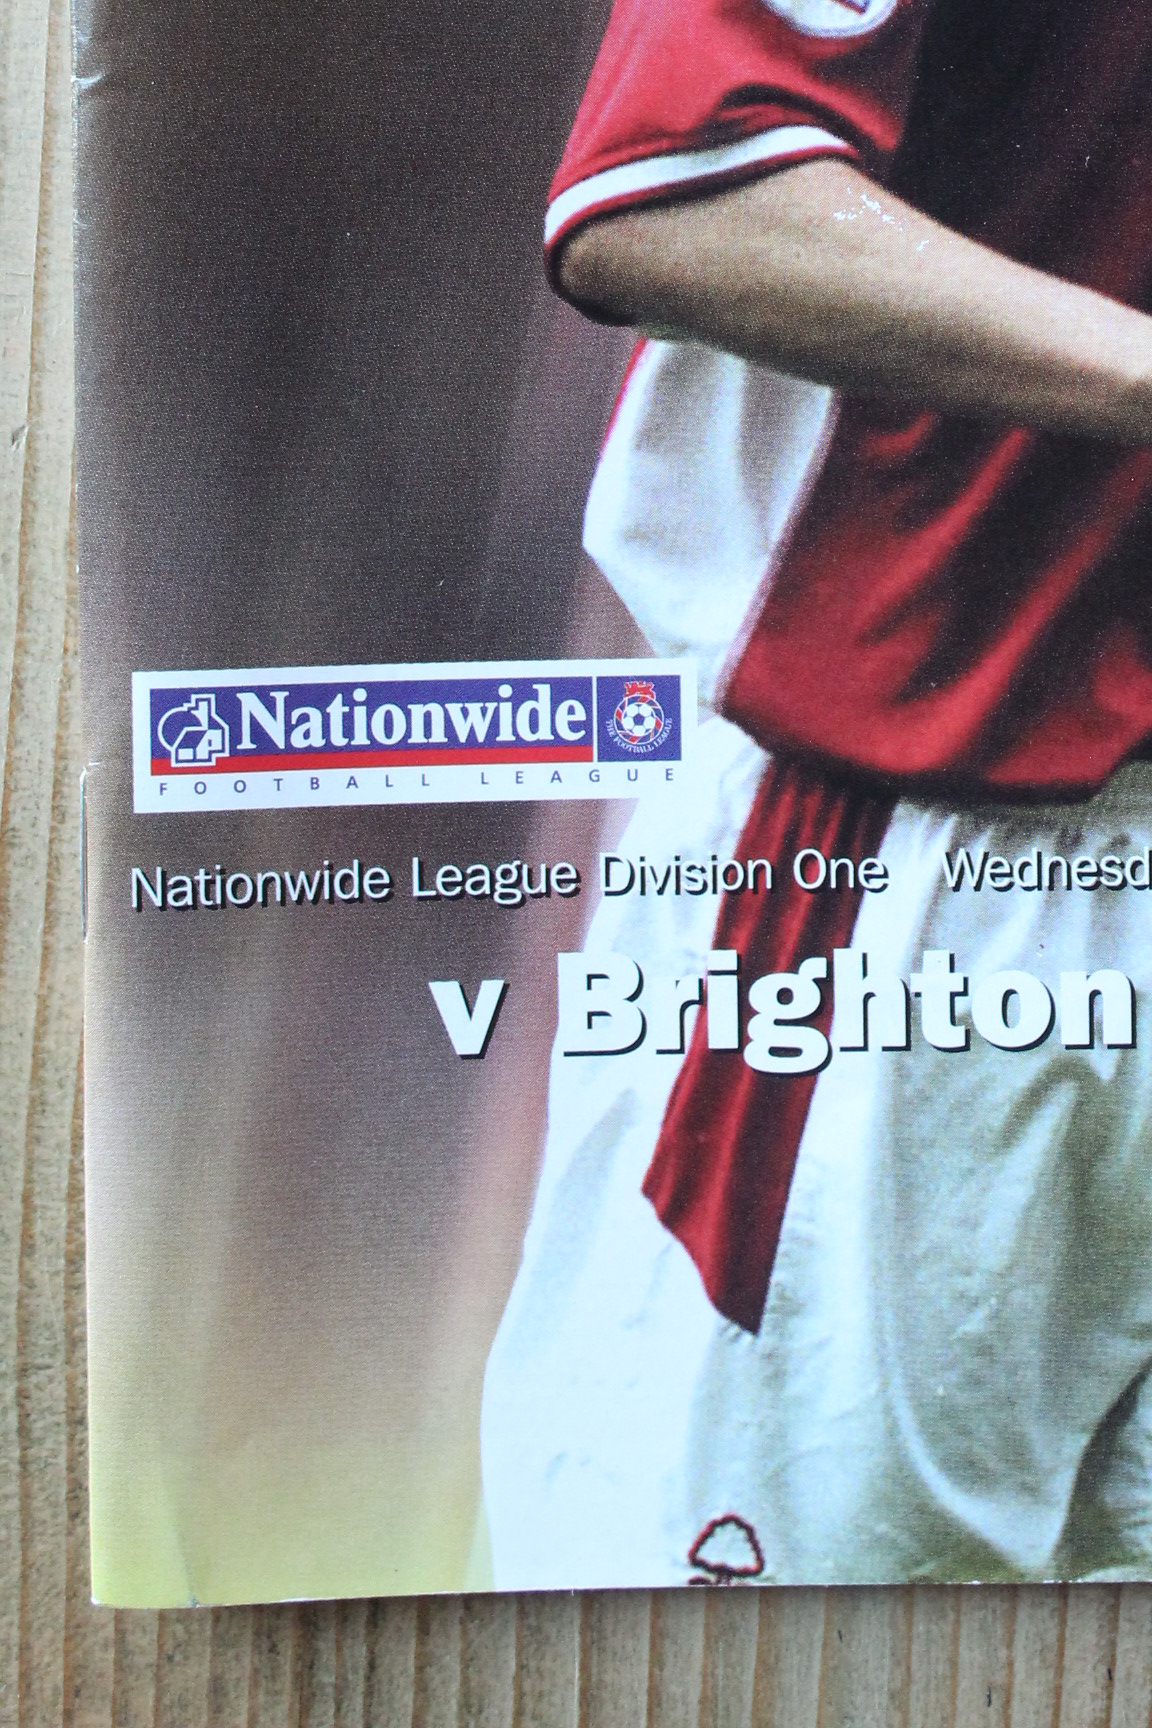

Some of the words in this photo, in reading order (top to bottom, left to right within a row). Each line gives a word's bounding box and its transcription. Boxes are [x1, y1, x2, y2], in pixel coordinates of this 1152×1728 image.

[235, 683, 587, 751] Nationwide
[159, 771, 431, 796] FOOTBALL
[480, 767, 675, 786] LEAGUE
[131, 859, 392, 909] Nationwide
[411, 855, 580, 908] League
[601, 850, 774, 896] Division
[792, 848, 890, 893] One
[429, 979, 506, 1059] v
[555, 947, 1137, 1074] Brighton
